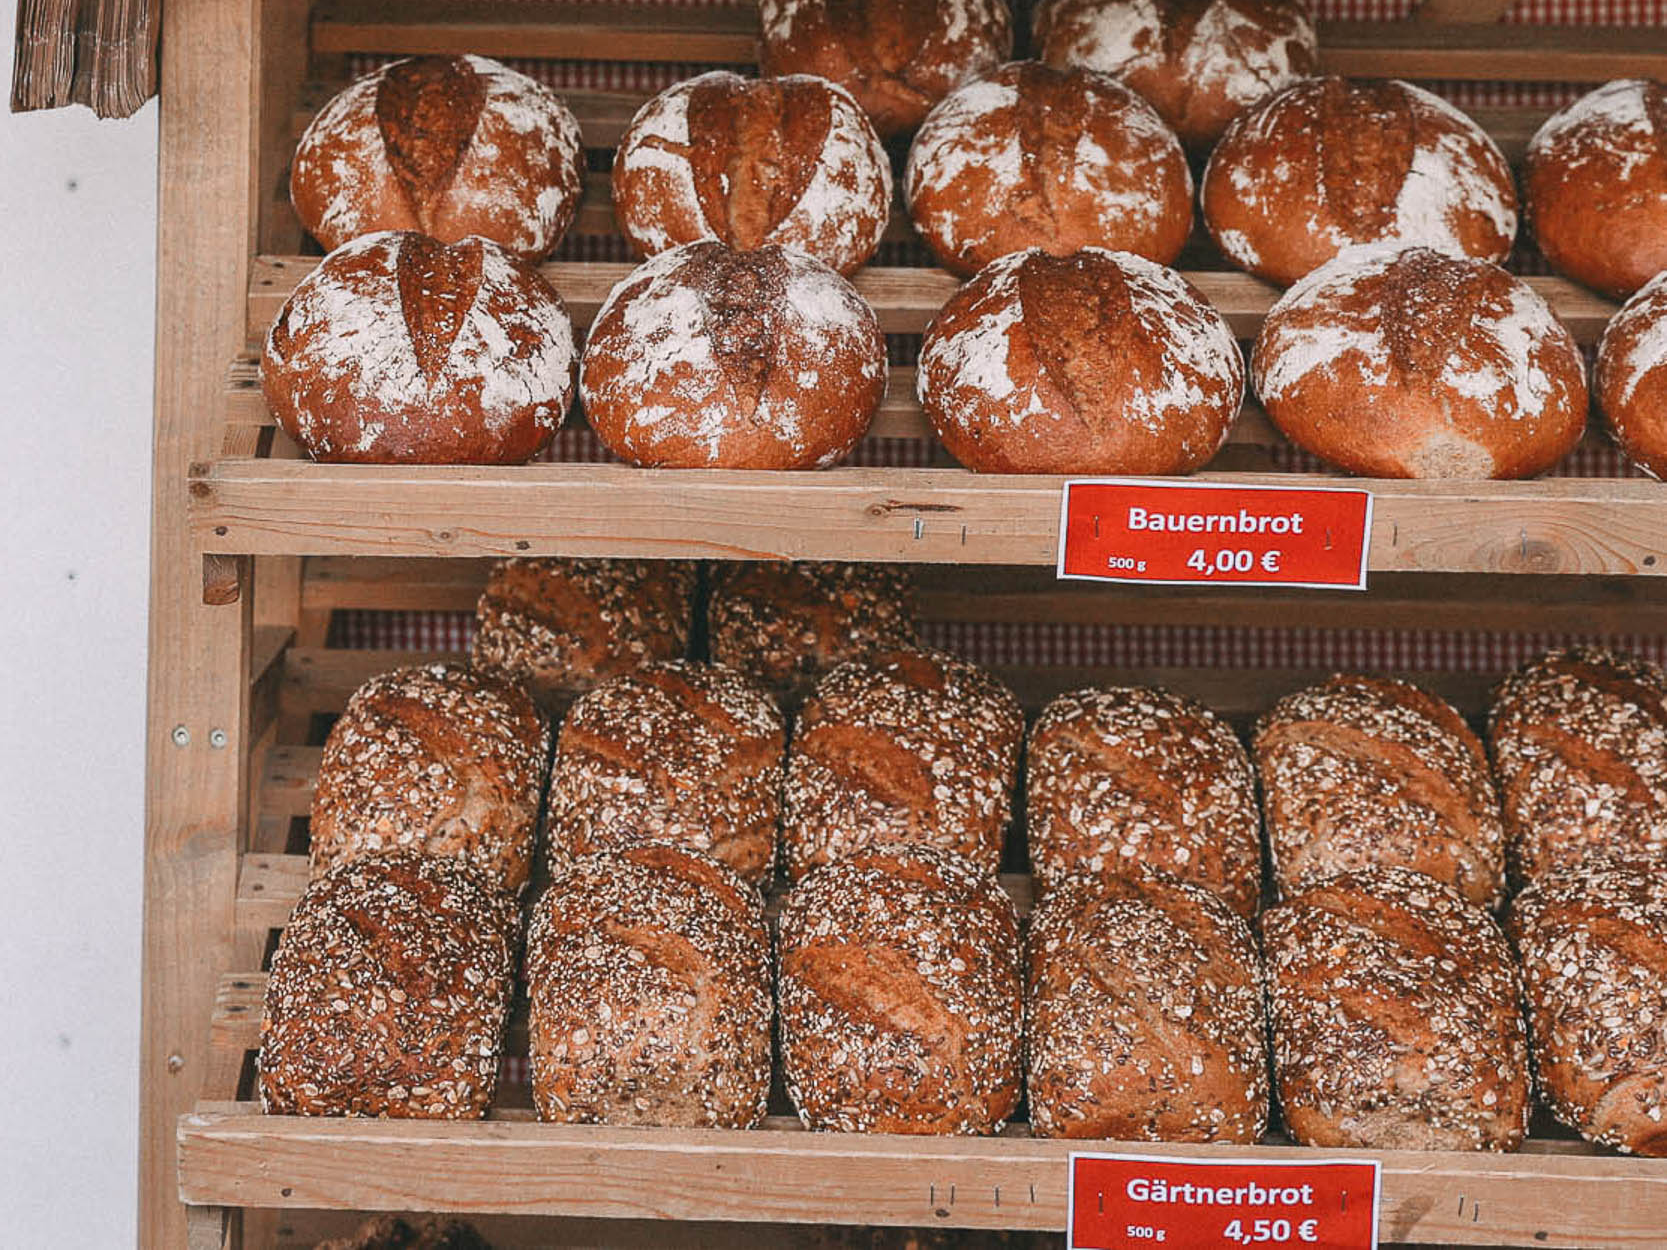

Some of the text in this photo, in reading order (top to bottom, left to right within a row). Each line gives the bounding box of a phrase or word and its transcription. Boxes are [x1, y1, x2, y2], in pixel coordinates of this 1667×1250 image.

[1129, 508, 1303, 533] Bauernbrot
[1108, 557, 1146, 571] 500 g
[1187, 550, 1280, 575] 4,00 €
[1127, 1179, 1313, 1205] Gärtnerbrot
[1128, 1226, 1165, 1241] 500 g
[1224, 1220, 1318, 1244] 4,50 €
